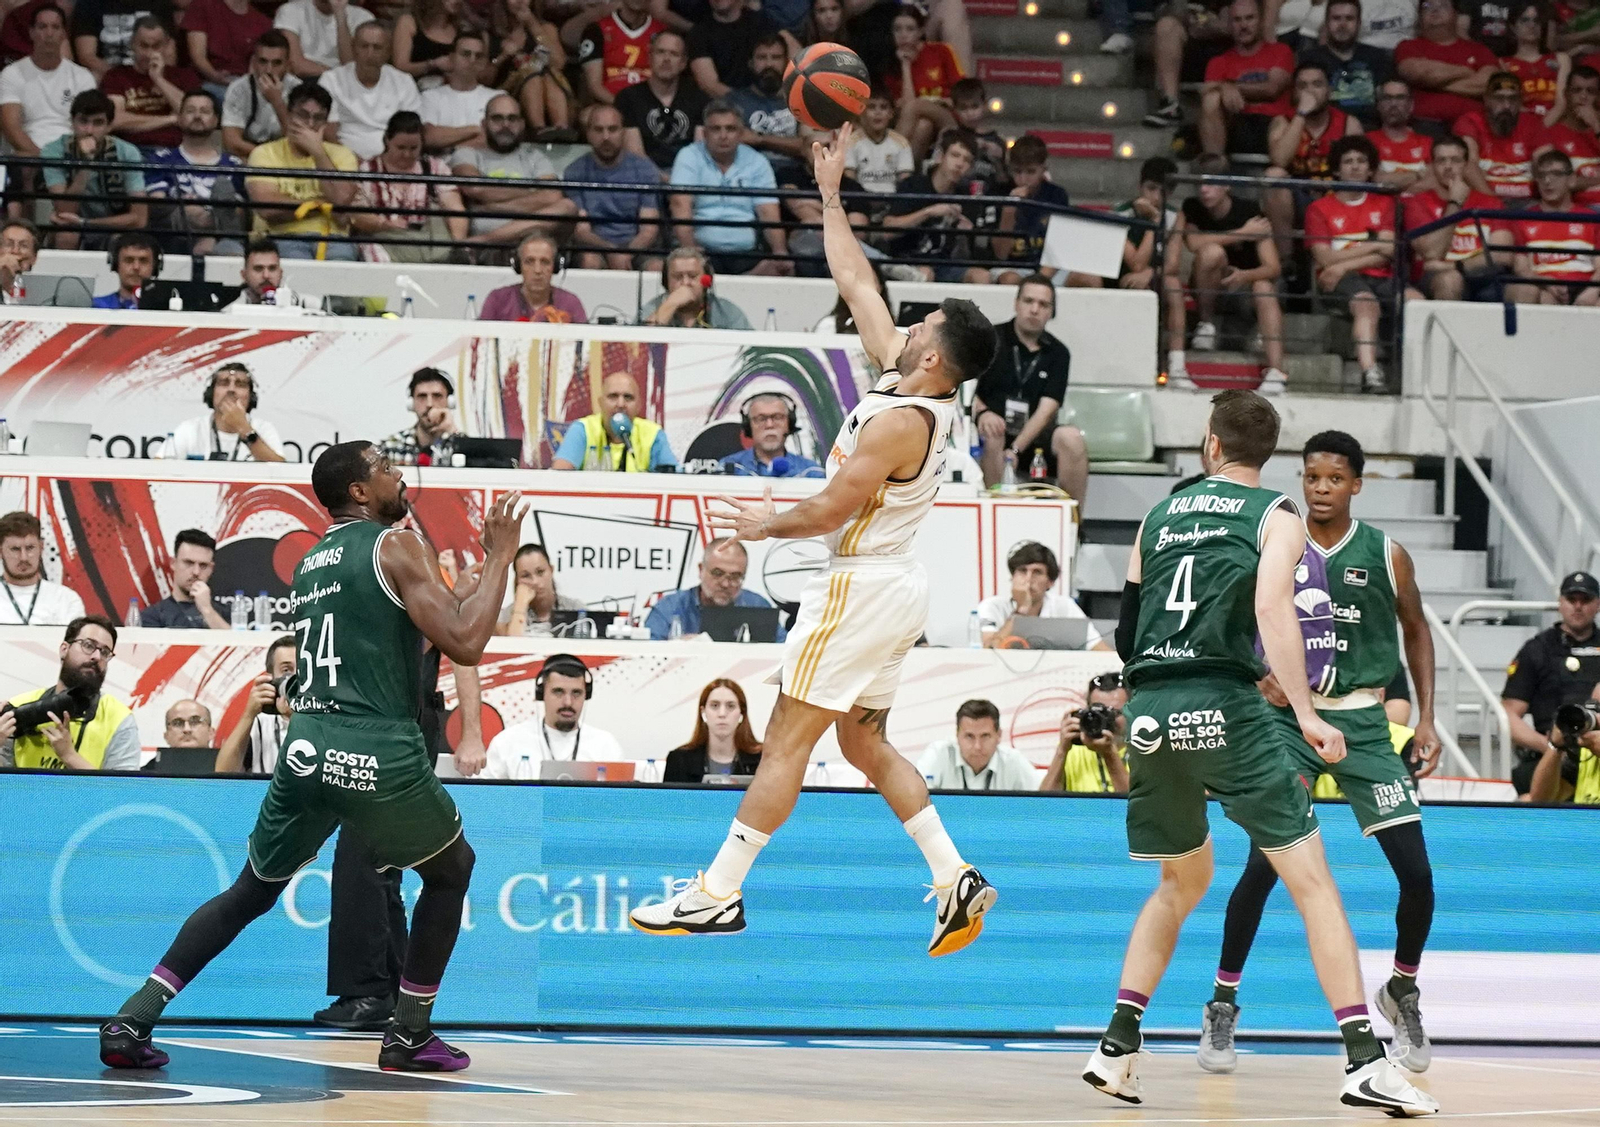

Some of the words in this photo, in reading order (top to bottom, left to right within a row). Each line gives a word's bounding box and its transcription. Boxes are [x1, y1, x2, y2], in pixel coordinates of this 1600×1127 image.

[1167, 494, 1246, 515] KALINOSKI
[300, 546, 343, 575] THOMAS
[557, 545, 671, 572] ¡TRIIPLE!
[1165, 555, 1197, 631] 4
[294, 612, 342, 693] 34
[1168, 709, 1226, 727] COSTA
[1168, 728, 1194, 740] DEL
[1197, 724, 1226, 738] SOL
[1170, 737, 1227, 751] MÁLAGA
[325, 748, 379, 769] COSTA
[323, 762, 348, 777] DEL
[350, 768, 378, 780] SOL
[322, 774, 377, 791] MÁLAGA
